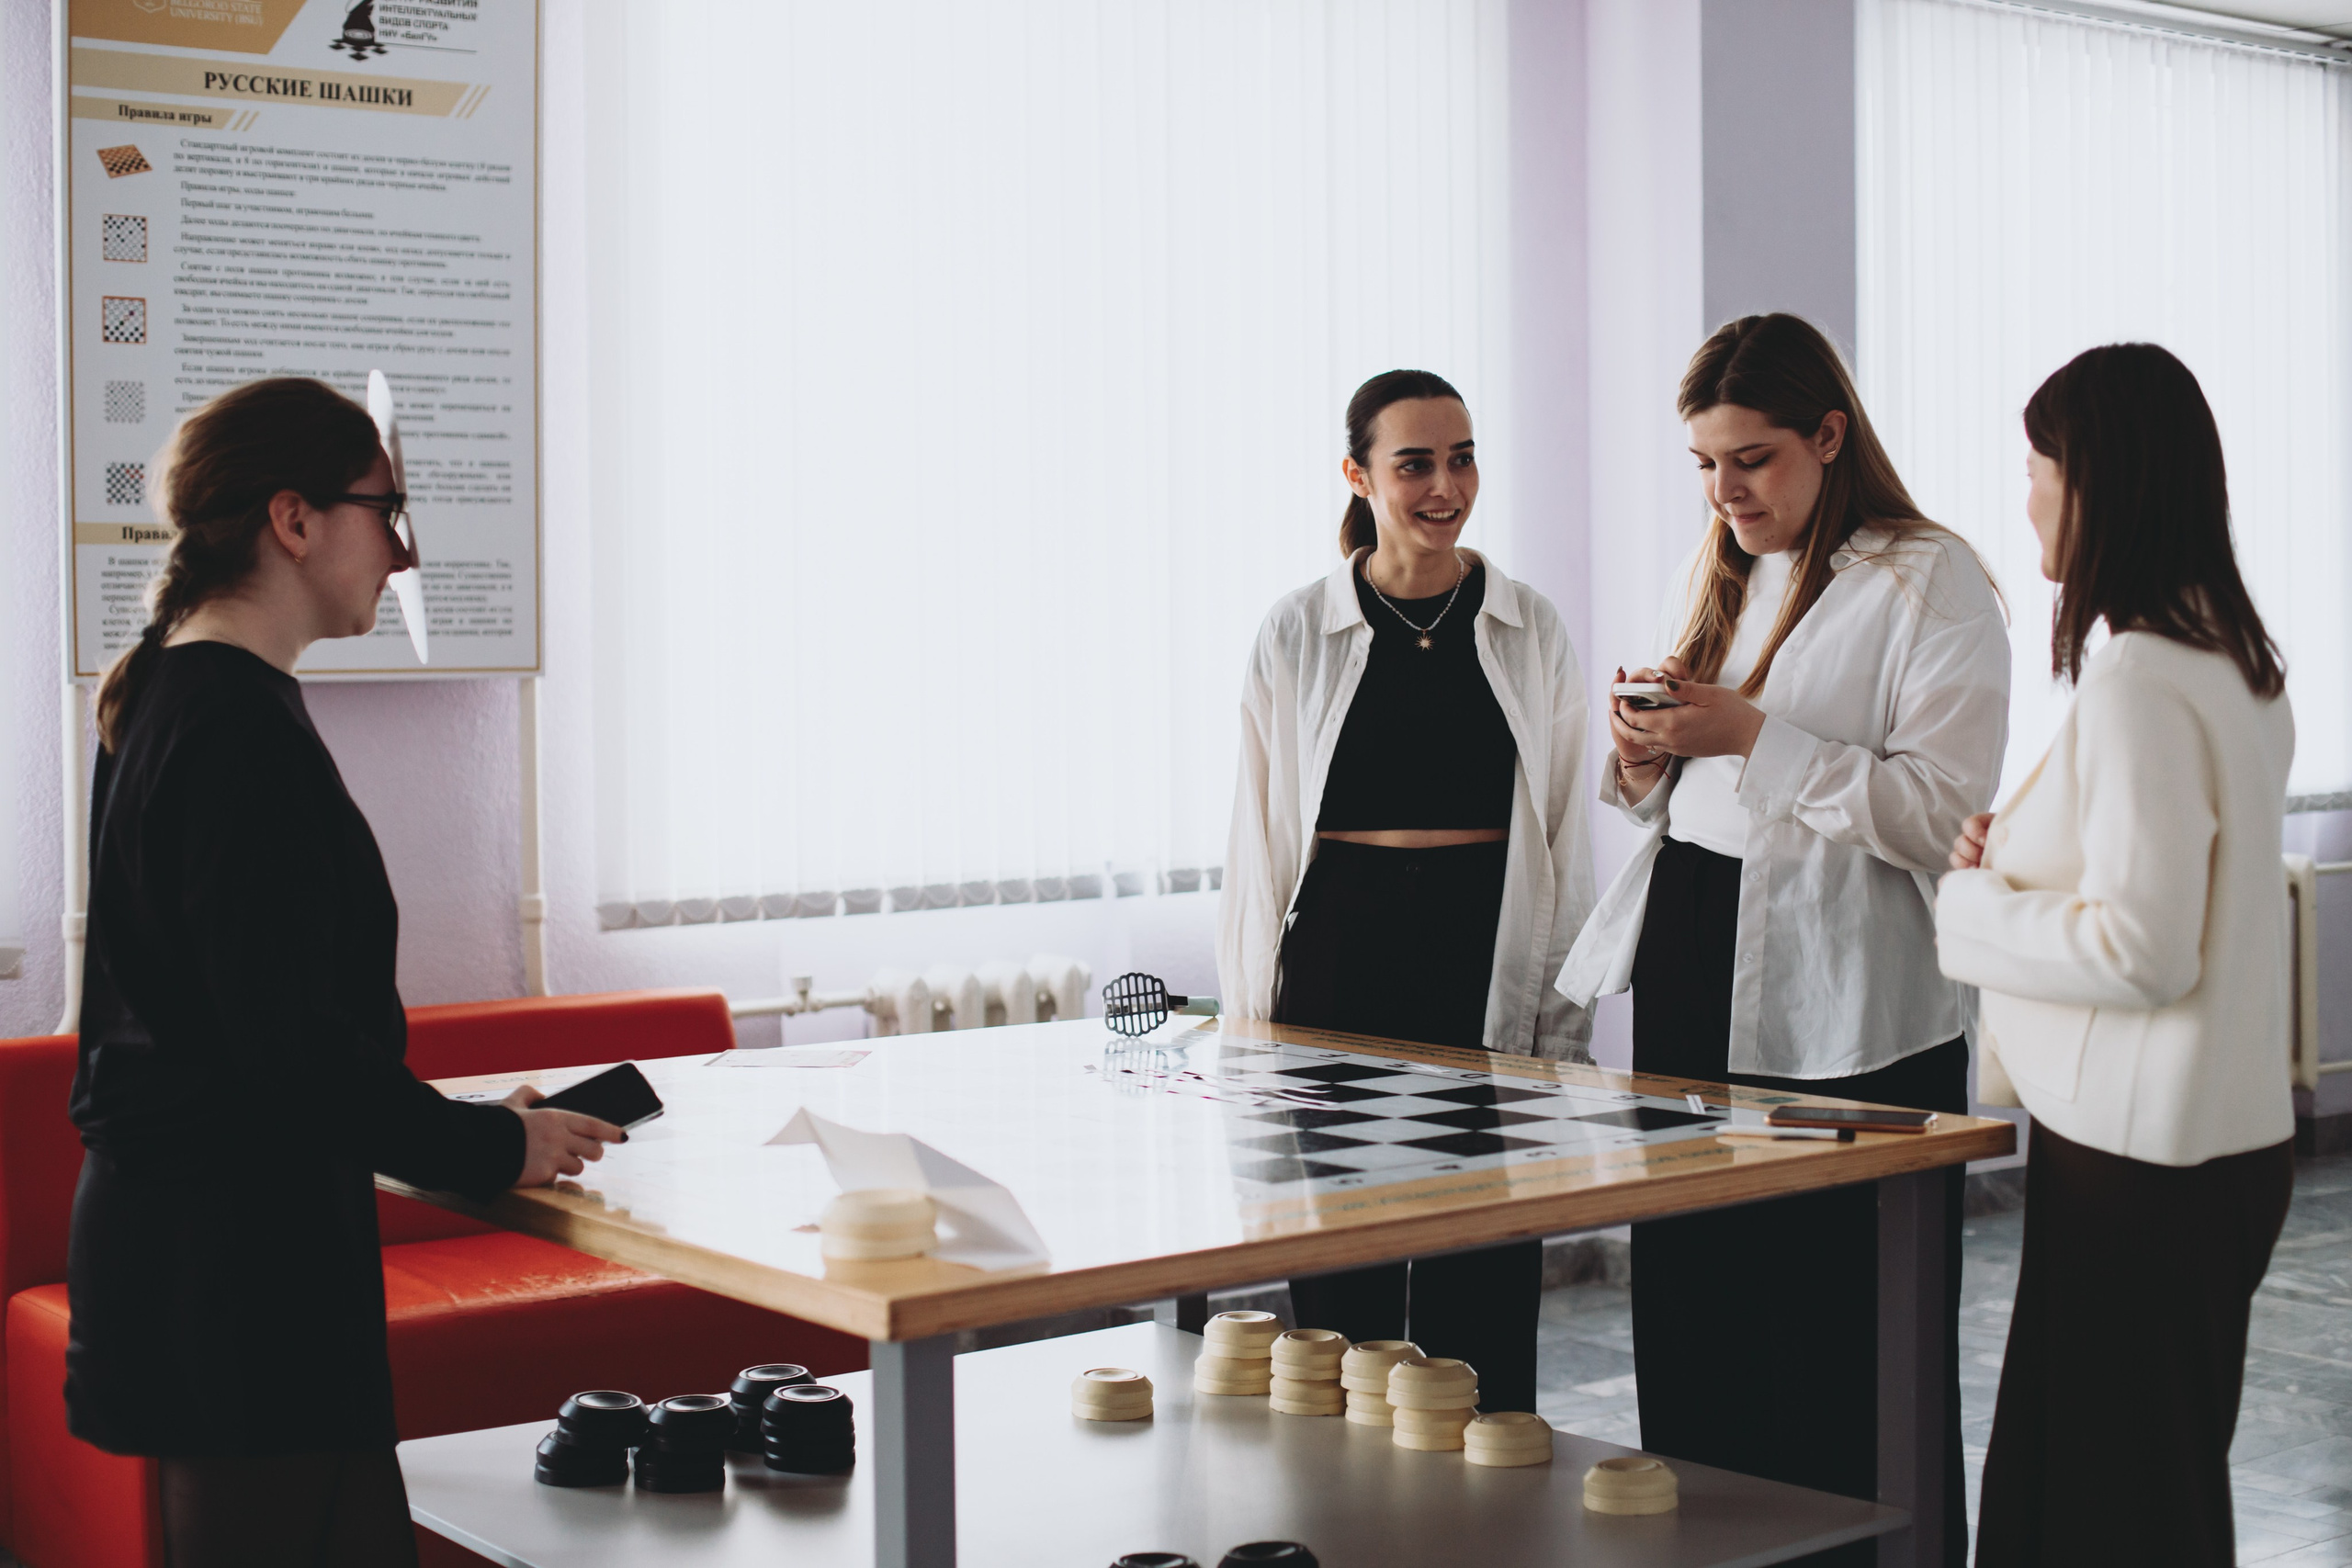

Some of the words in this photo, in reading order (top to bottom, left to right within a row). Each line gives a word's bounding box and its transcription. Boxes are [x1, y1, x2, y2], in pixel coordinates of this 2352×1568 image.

[170, 6, 232, 22] UNIVERSITY
[232, 2, 263, 14] STATE
[379, 4, 477, 20] ИНТЕЛЛЕКТУАЛЬНЫХ
[379, 16, 412, 27] ВИДОВ
[413, 19, 448, 30] СПОРТА
[204, 71, 312, 97] РУССКИЕ
[320, 82, 413, 107] ШАШКИ
[118, 104, 175, 120] Правила
[179, 112, 212, 125] игры
[121, 526, 175, 543] Прави
